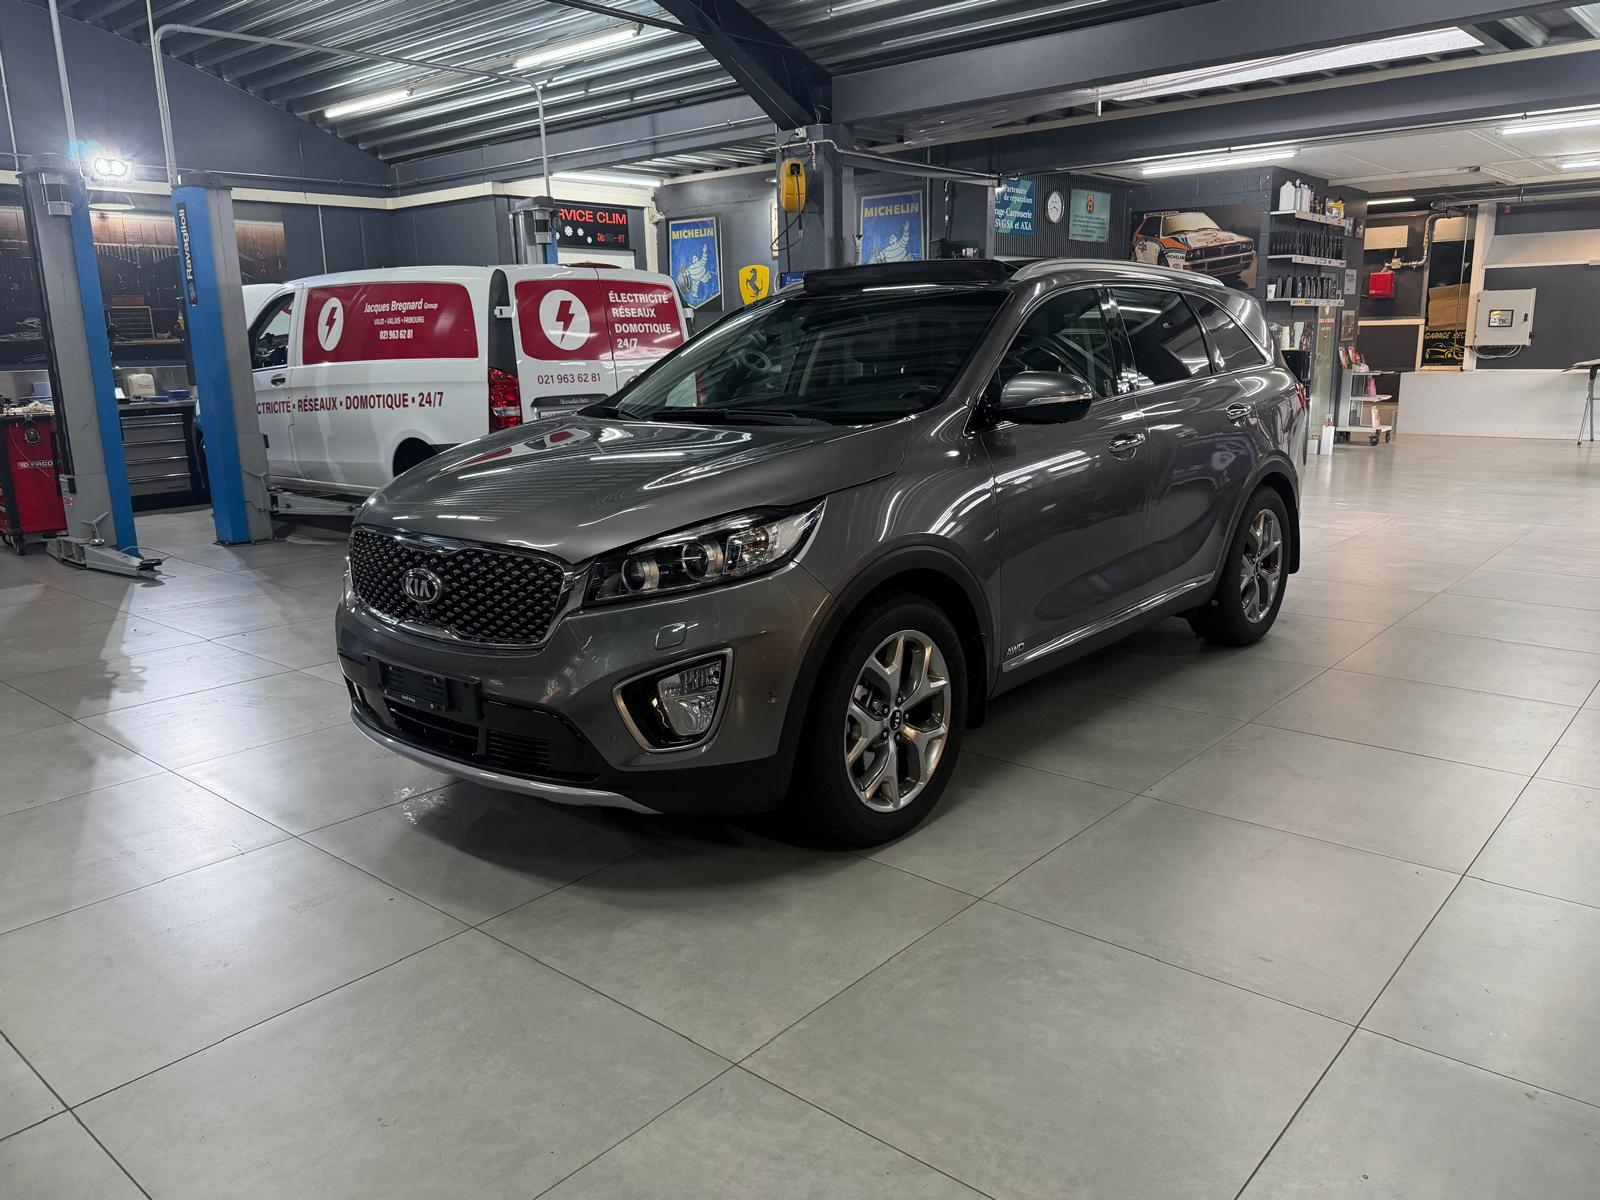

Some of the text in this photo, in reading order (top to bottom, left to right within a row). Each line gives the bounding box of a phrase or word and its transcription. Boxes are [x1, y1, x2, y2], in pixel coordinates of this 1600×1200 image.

[863, 201, 920, 218] MICHELIN
[596, 211, 627, 225] CLIM
[1020, 221, 1032, 231] AXA
[671, 228, 715, 240] MICHELIN
[178, 209, 193, 280] Ravaglioli
[608, 290, 669, 304] ÉLECTRICITÉ
[364, 303, 390, 315] Jacques
[391, 298, 423, 313] Bregnard
[612, 305, 656, 318] RÉSEAUX
[379, 329, 414, 340] 021 963 62 81
[614, 322, 672, 334] DOMOTIQUE
[1424, 331, 1451, 340] GARAGE
[616, 337, 638, 349] 24/7
[537, 372, 601, 385] 021 963 62 81
[297, 395, 338, 413] RÉSEAUX
[345, 392, 409, 410] DOMOTIQUE
[418, 391, 444, 408] 24/7
[405, 576, 431, 598] KIA
[1004, 642, 1025, 658] AWD
